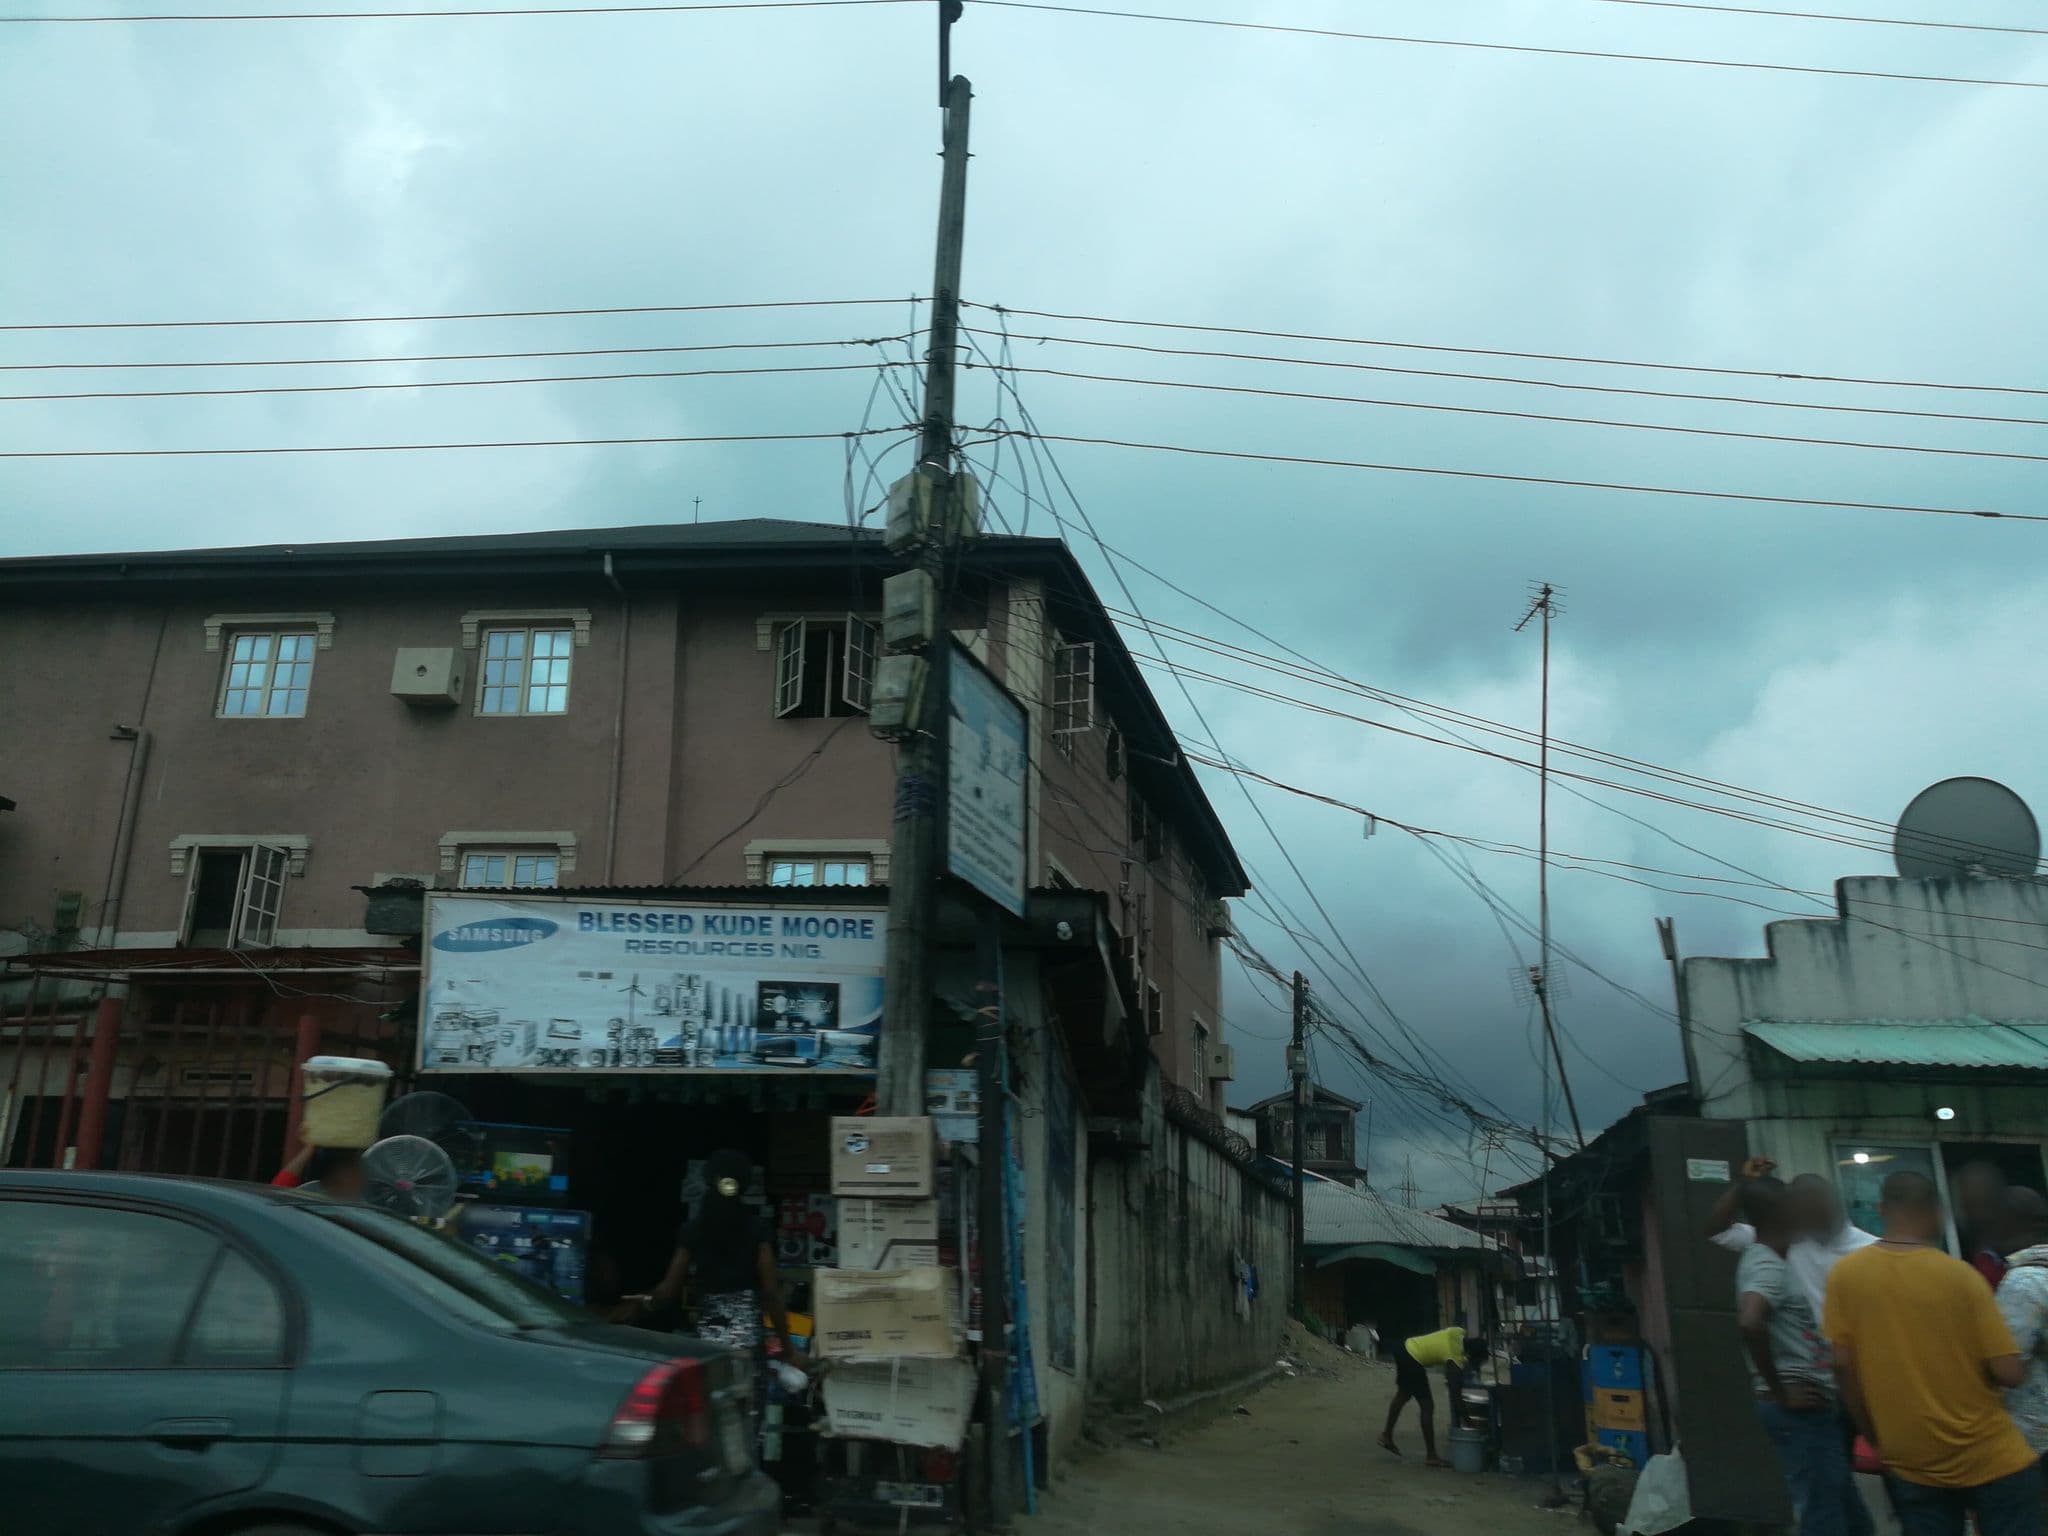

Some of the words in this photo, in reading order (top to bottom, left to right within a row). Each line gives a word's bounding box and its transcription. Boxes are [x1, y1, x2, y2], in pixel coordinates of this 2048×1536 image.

[447, 927, 544, 942] SAMSUNG
[580, 911, 693, 934] BLESSED
[704, 914, 773, 936] KUDE
[783, 917, 875, 940] MOORE
[625, 938, 774, 957] RESOURCES
